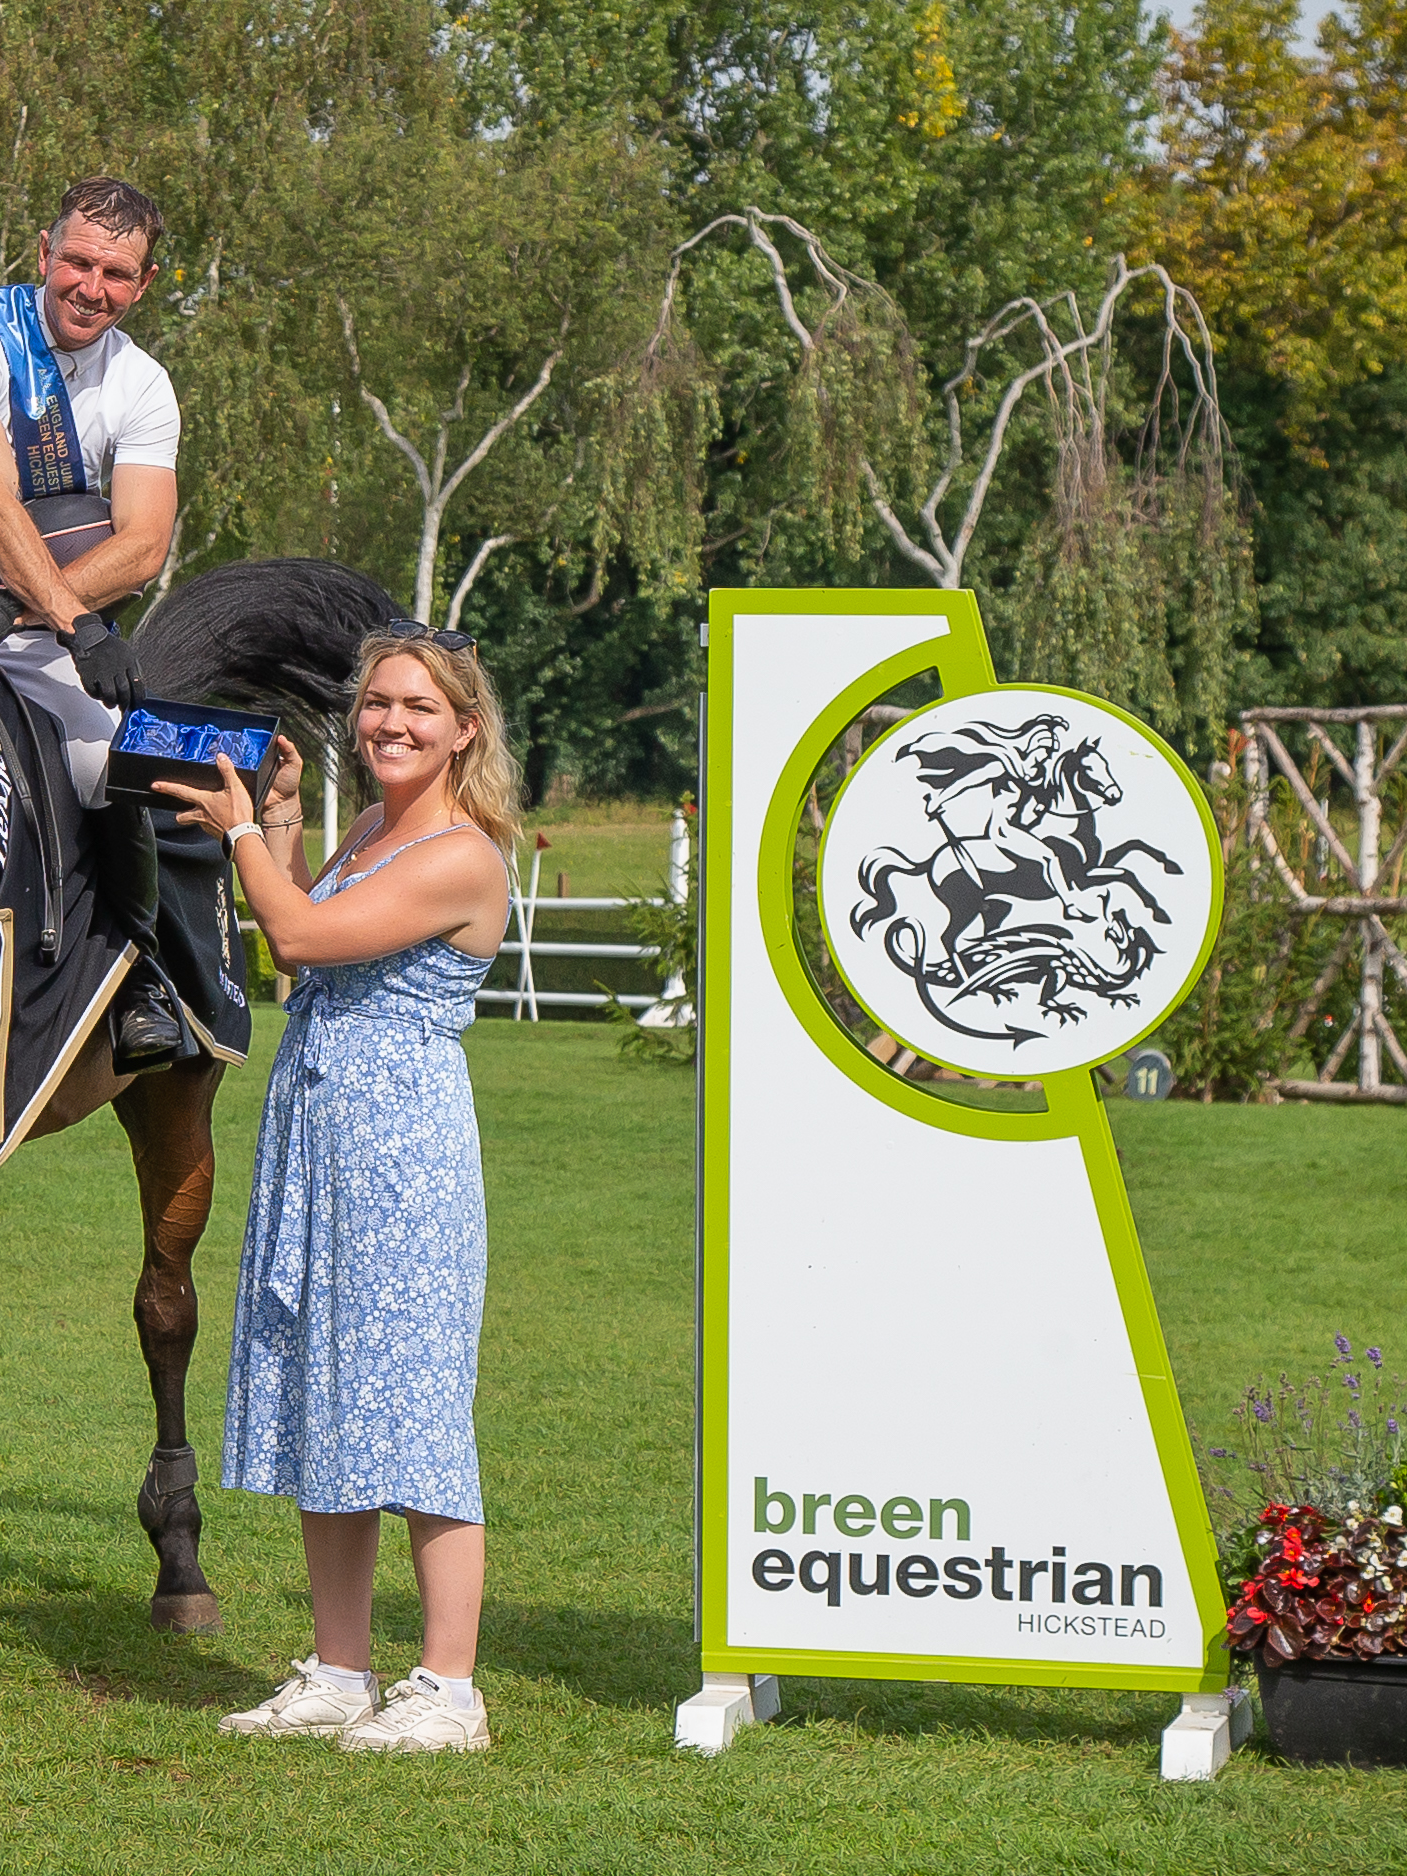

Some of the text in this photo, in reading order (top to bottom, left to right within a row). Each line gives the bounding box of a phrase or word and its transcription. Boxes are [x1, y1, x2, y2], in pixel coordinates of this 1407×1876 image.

[46, 395, 69, 458] ENGLAND
[1136, 1067, 1159, 1095] 11
[753, 1476, 971, 1541] breen
[751, 1546, 1163, 1608] equestrian
[1017, 1613, 1166, 1639] HICKSTEAD
